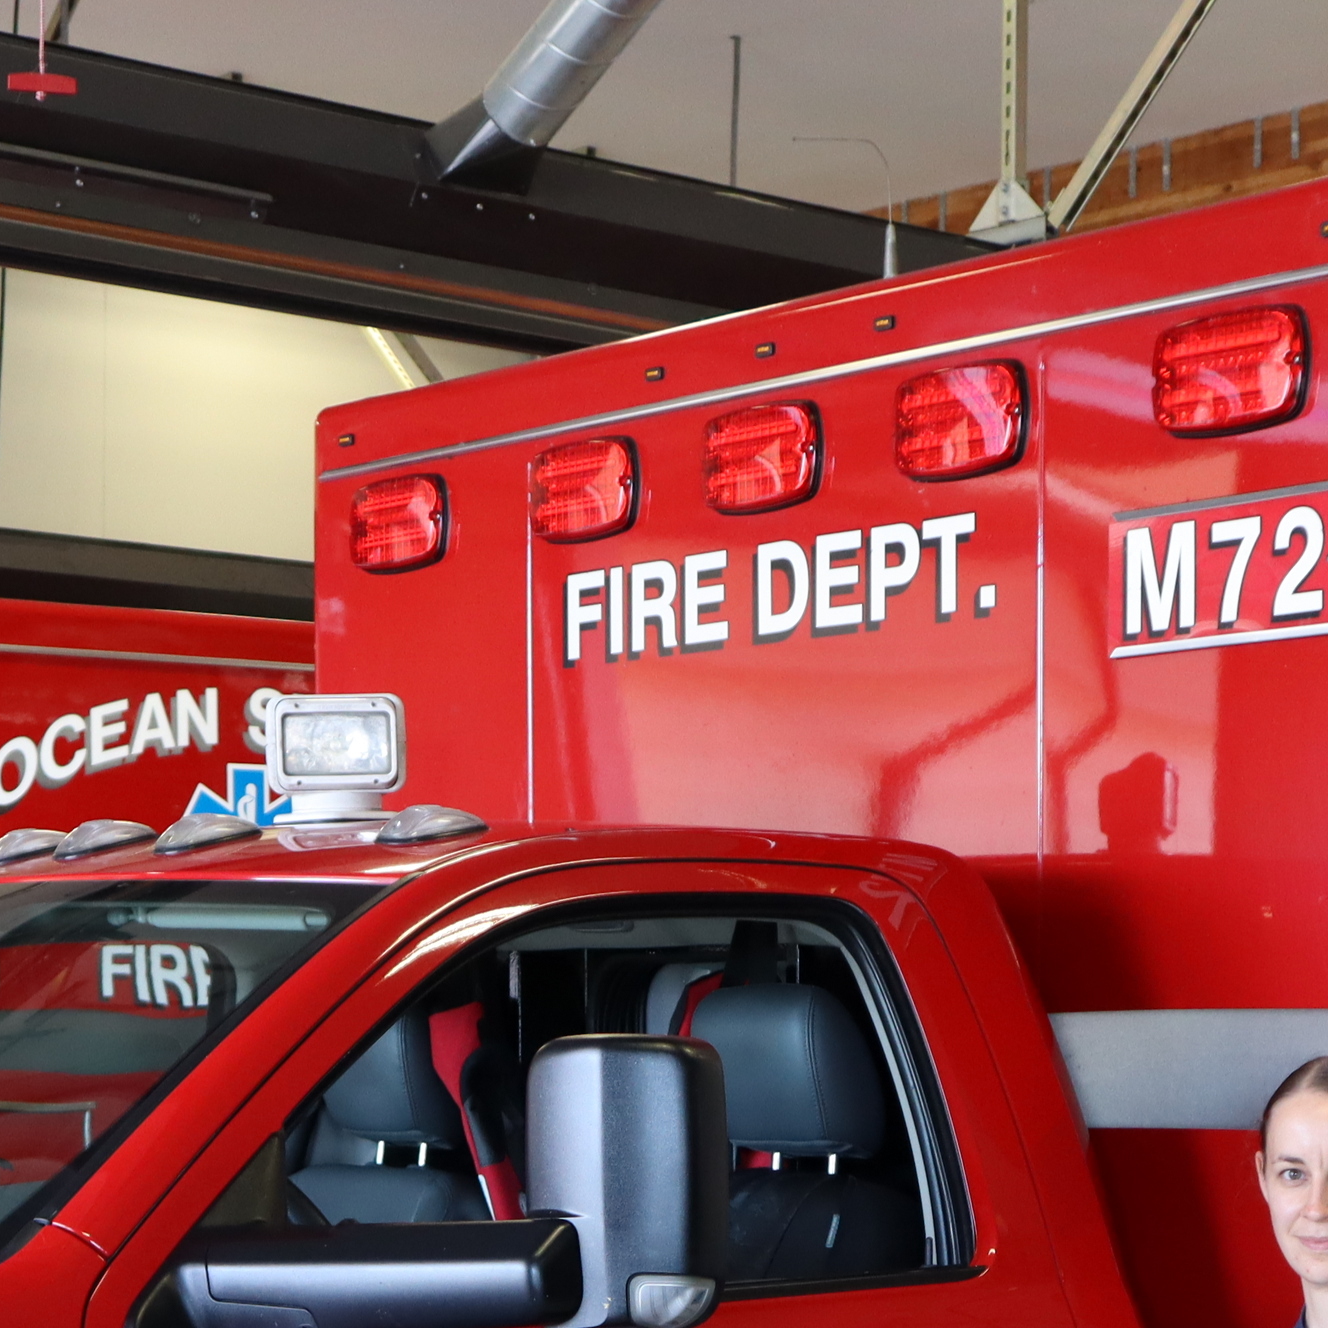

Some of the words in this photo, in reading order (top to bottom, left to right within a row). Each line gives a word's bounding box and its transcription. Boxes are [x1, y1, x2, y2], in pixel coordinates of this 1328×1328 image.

[565, 548, 730, 664] FIRE
[755, 511, 998, 641] DEPT.
[1124, 504, 1326, 638] M72
